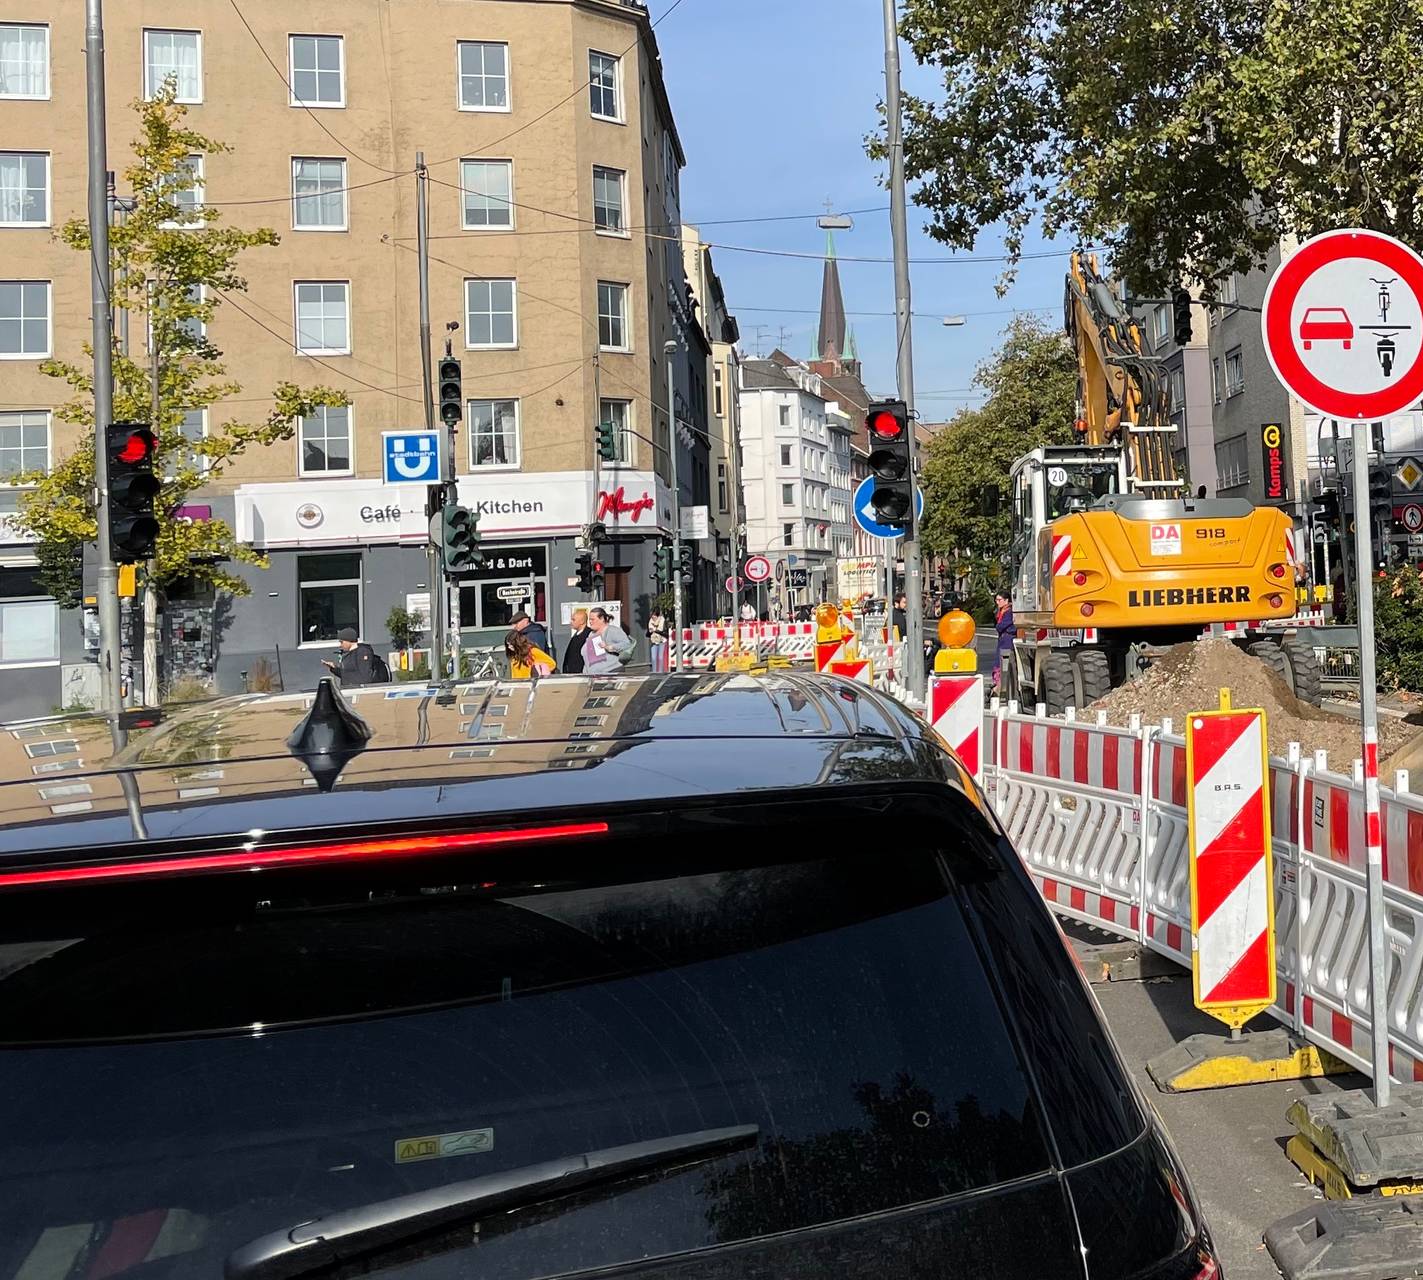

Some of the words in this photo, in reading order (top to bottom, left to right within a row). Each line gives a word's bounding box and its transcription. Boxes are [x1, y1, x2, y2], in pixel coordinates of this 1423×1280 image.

[1052, 470, 1065, 482] 20
[1269, 448, 1283, 497] Kamps
[360, 503, 401, 522] Café
[476, 500, 543, 515] Kitchen
[1152, 526, 1179, 540] DA
[1196, 528, 1226, 539] 918
[496, 558, 505, 569] &
[508, 557, 533, 569] Dart
[1128, 585, 1251, 608] LIEBHERR
